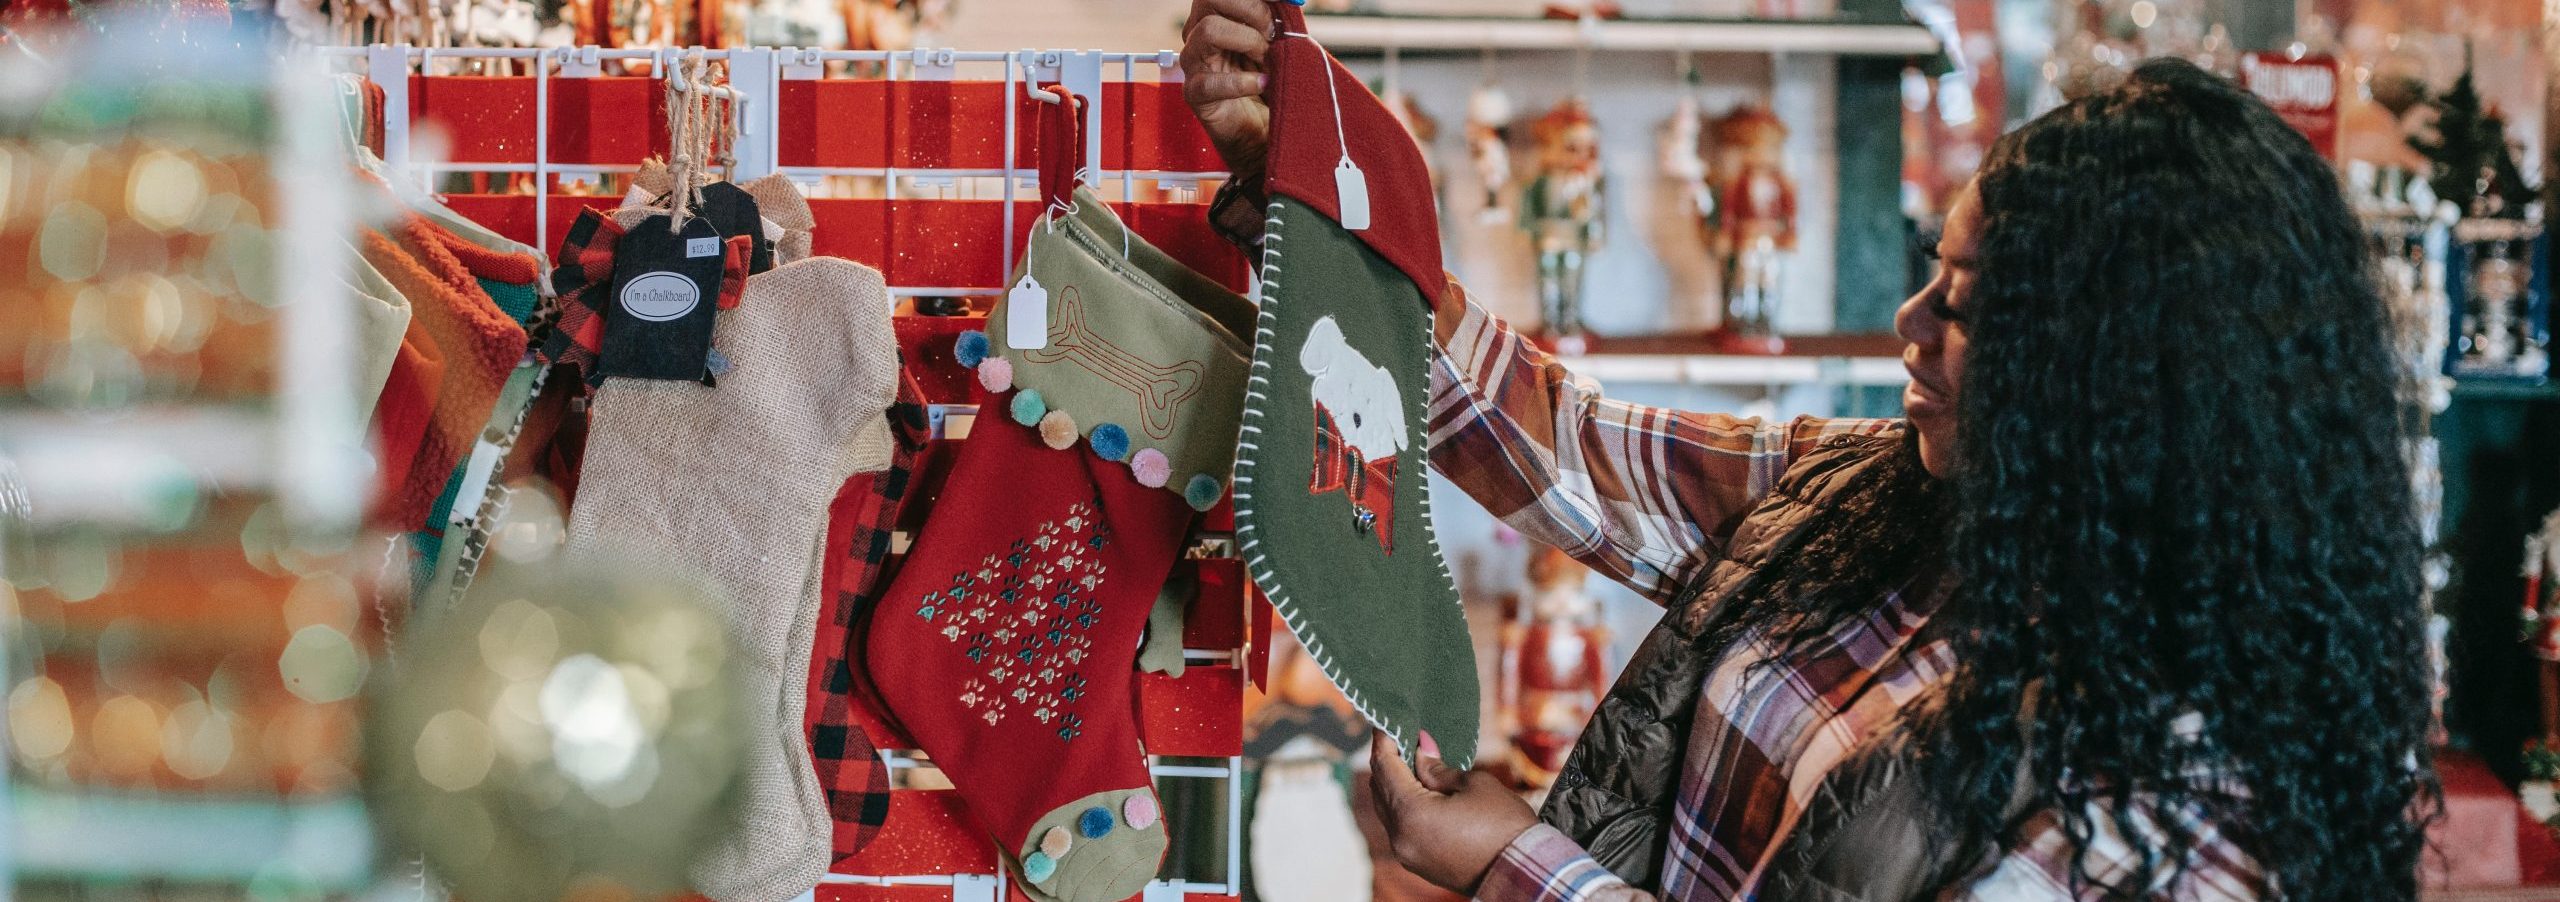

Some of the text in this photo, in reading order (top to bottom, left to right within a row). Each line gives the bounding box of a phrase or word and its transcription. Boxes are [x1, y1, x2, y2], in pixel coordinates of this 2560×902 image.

[692, 243, 715, 254] $12.99
[630, 289, 641, 302] I'm
[649, 288, 692, 302] Chalkboard
